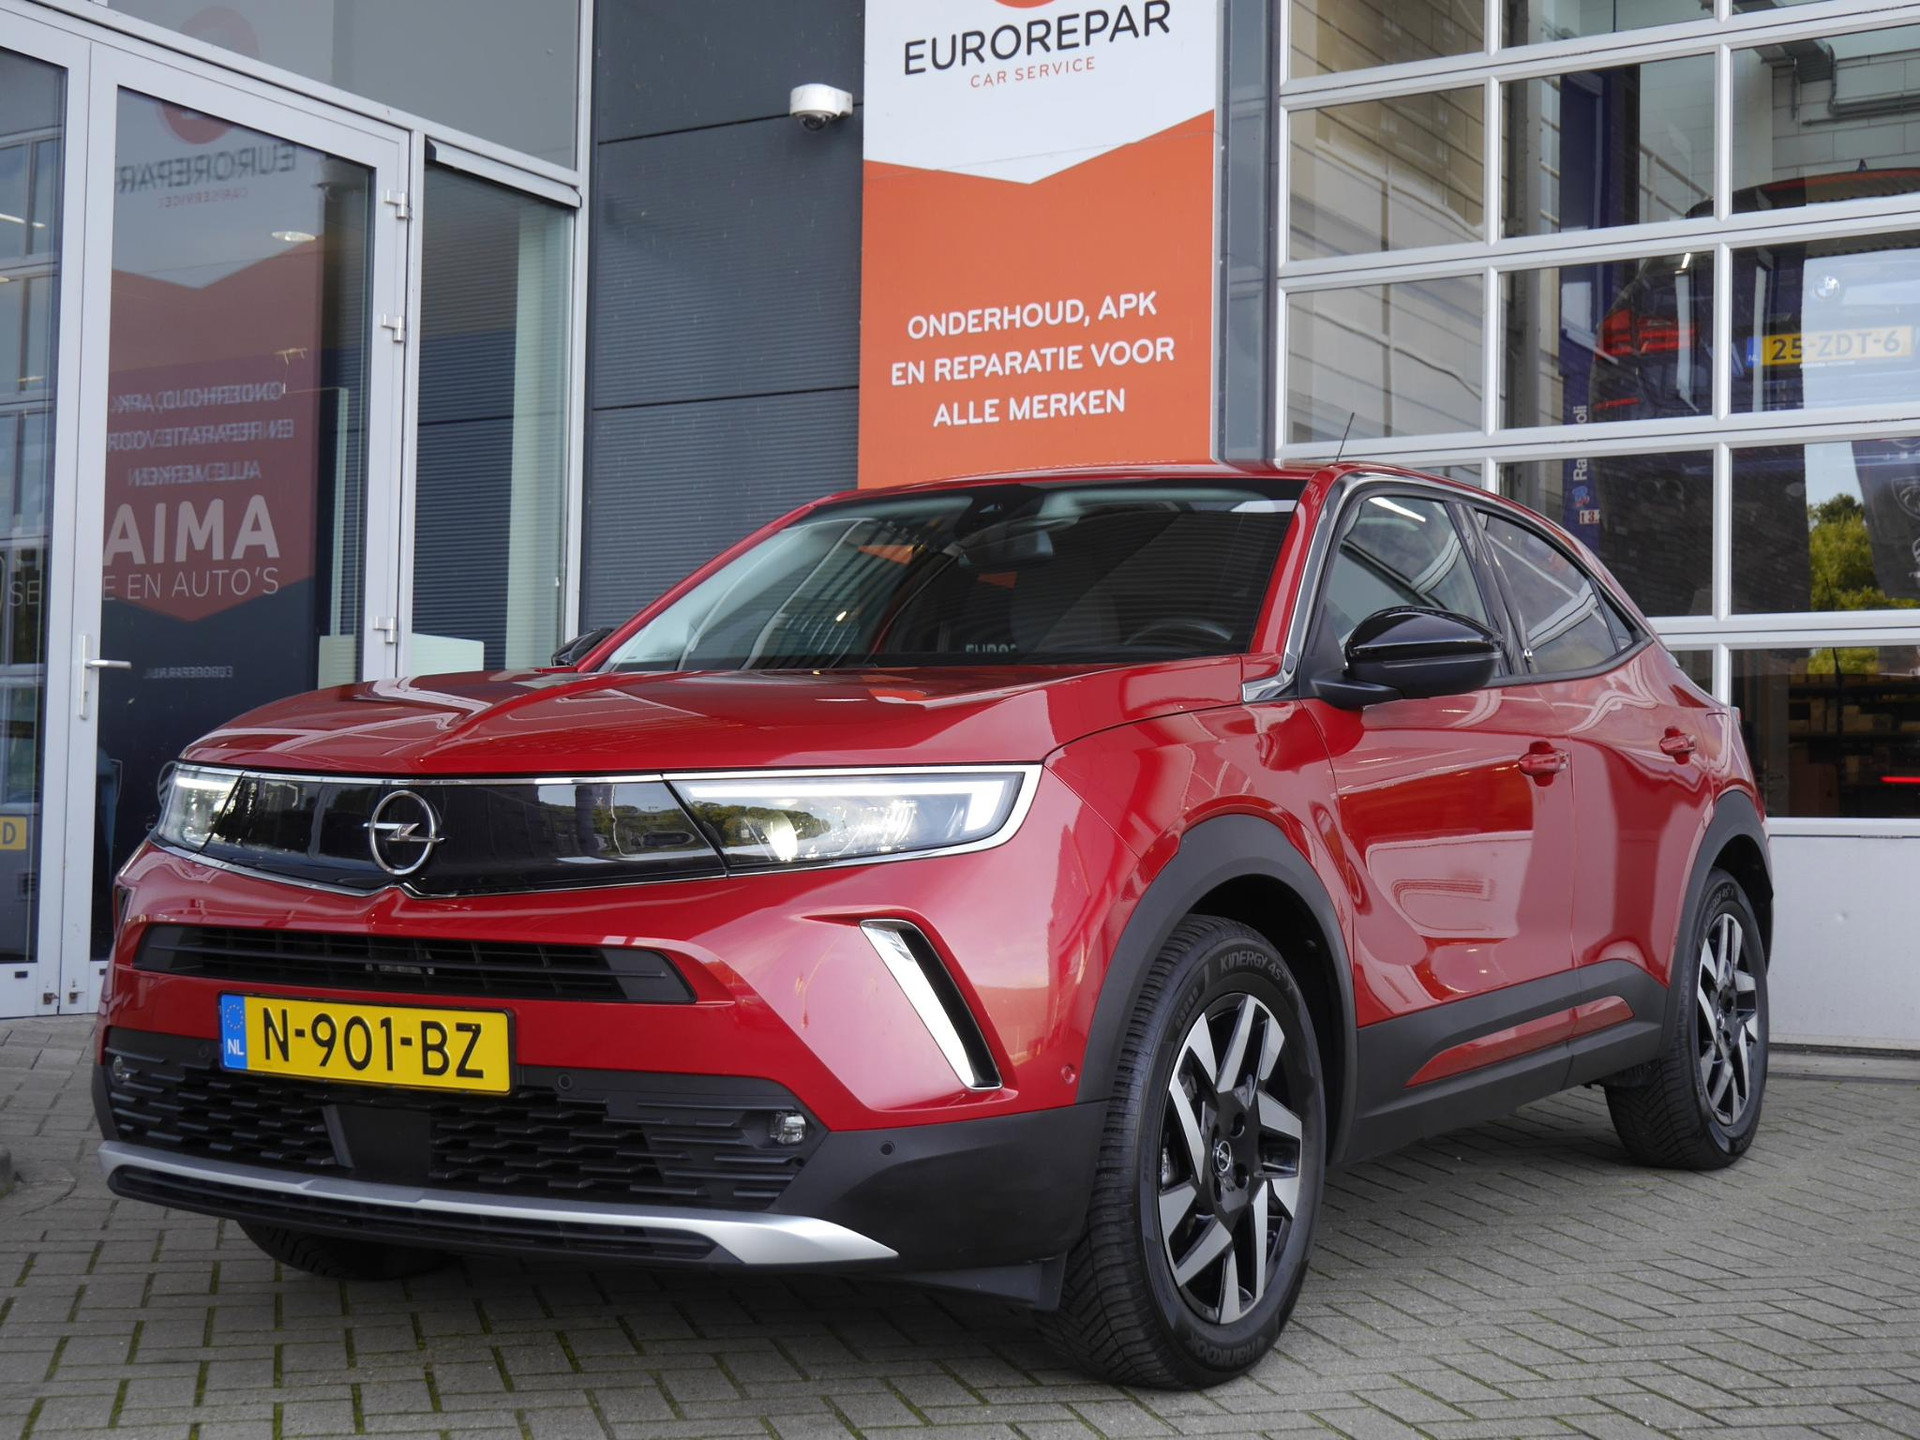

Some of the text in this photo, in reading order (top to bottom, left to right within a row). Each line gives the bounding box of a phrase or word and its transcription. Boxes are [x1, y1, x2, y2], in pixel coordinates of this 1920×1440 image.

[904, 0, 1171, 75] EUROREPAR
[970, 56, 1096, 88] CAR SERVICE
[907, 290, 1158, 340] ONDERHOUD, APK
[891, 336, 1176, 386] EN REPARATIE VOOR
[1771, 330, 1901, 361] 25-ZDT-6
[932, 387, 1126, 428] ALLE MERKEN
[127, 572, 162, 601] EN
[171, 566, 280, 598] AUTO'S
[1219, 950, 1269, 973] KINERGY
[226, 1037, 245, 1057] NL
[262, 1006, 485, 1080] N-901-BZ
